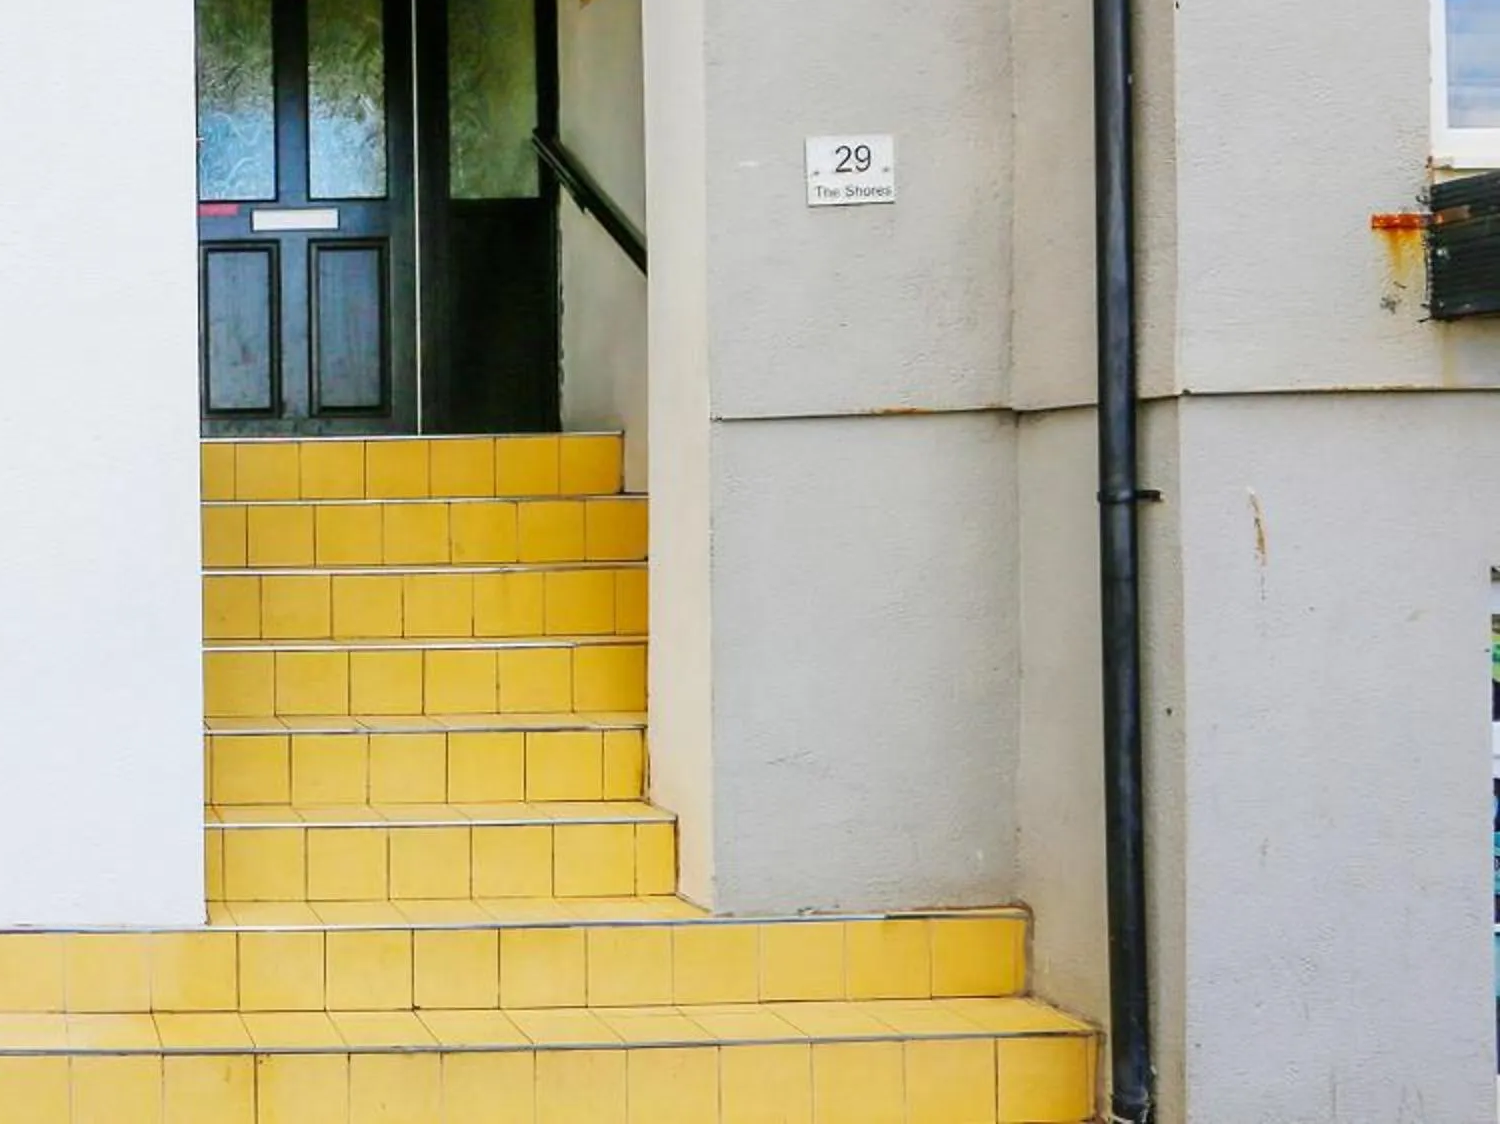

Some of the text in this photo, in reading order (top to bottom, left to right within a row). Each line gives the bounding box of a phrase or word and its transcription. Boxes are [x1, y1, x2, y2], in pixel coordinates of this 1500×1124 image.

[835, 144, 871, 173] 29
[815, 184, 893, 198] The Shores
